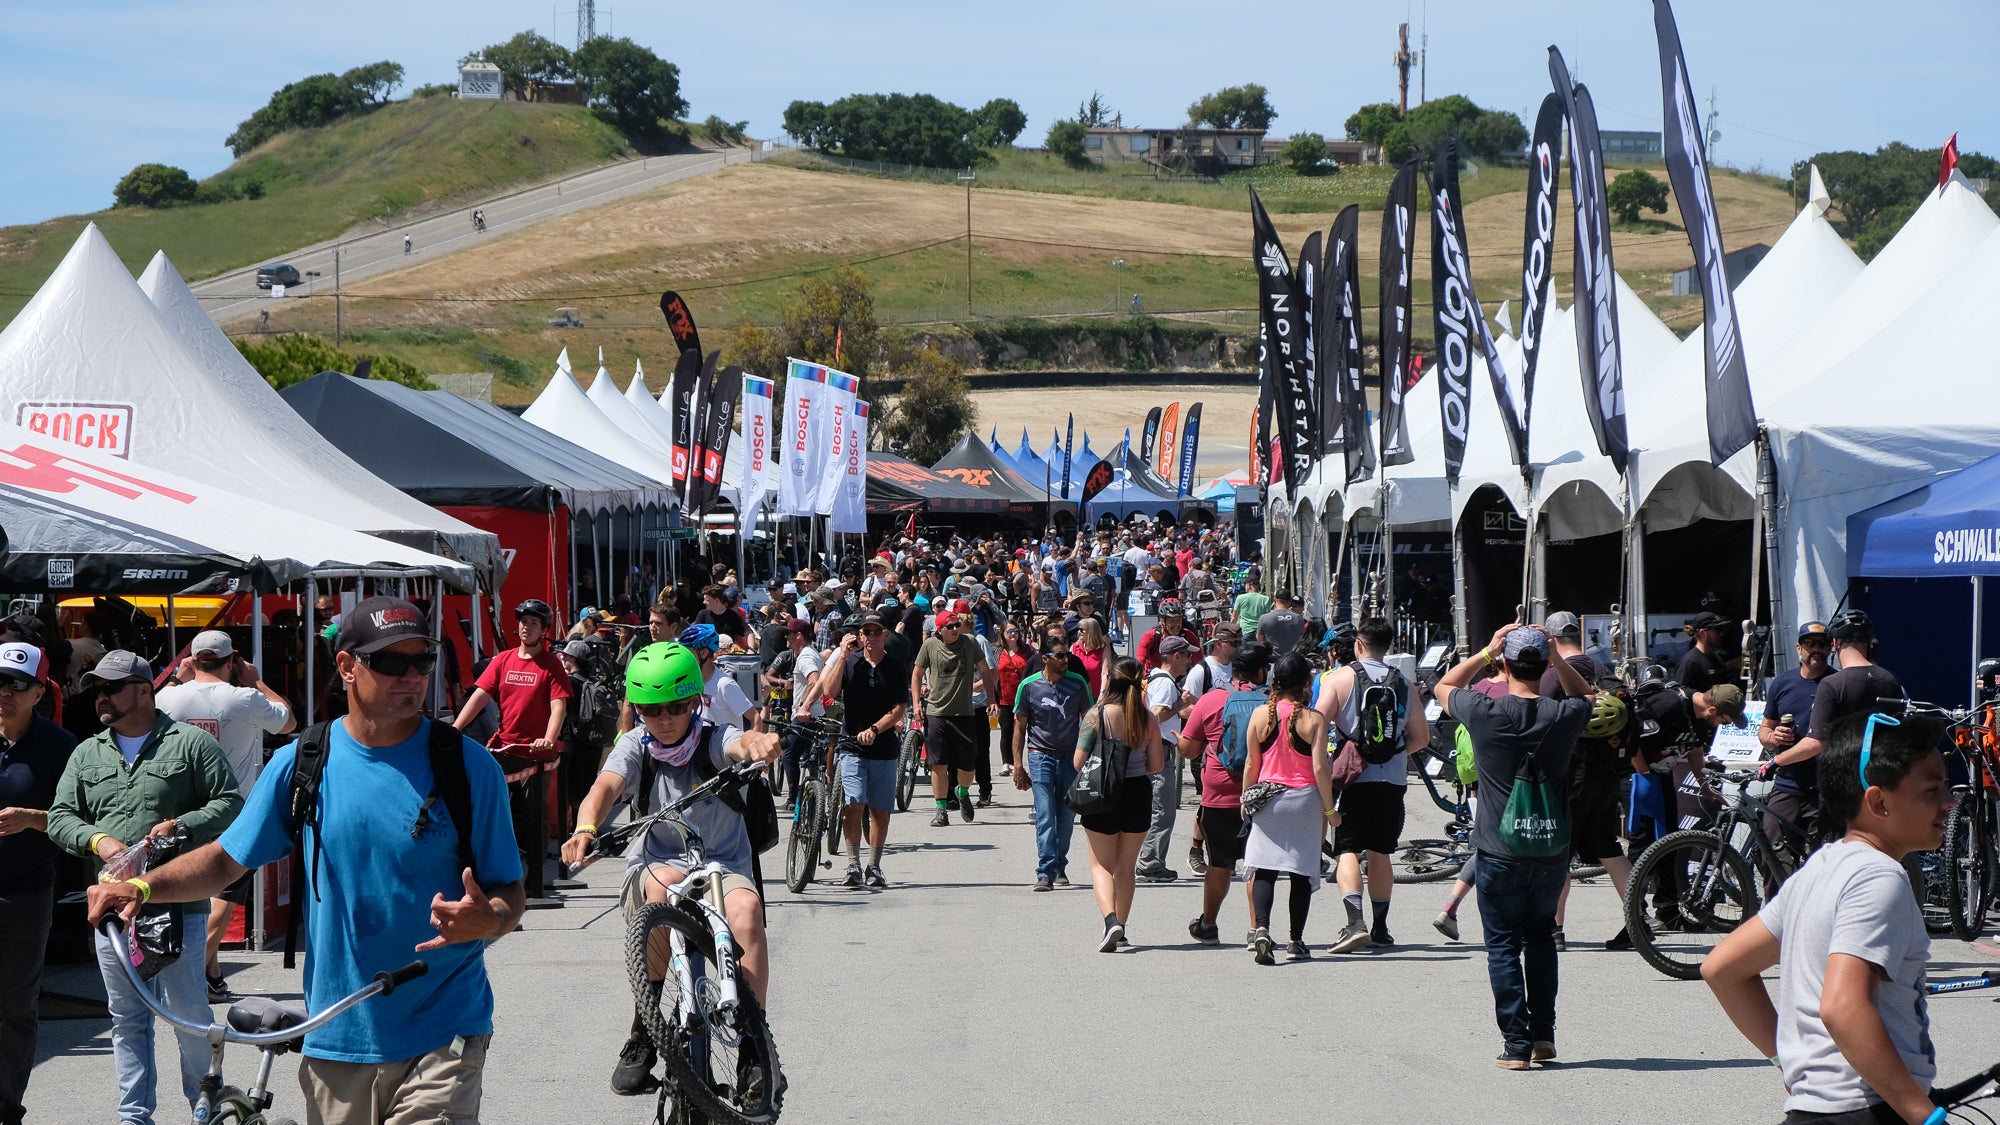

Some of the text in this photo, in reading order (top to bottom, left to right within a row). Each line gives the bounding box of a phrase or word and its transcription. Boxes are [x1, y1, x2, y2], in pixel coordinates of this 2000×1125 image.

[796, 398, 811, 452] BOSCH
[832, 405, 844, 455] BOSCH
[752, 415, 764, 472] BOSCH
[848, 430, 859, 476] BOSCH
[1485, 538, 1526, 546] PERFORMANC
[50, 561, 72, 573] ROCK
[122, 569, 189, 580] SRAM
[509, 674, 534, 682] BRXTN
[674, 679, 700, 697] GIRO
[1513, 818, 1532, 830] CAL
